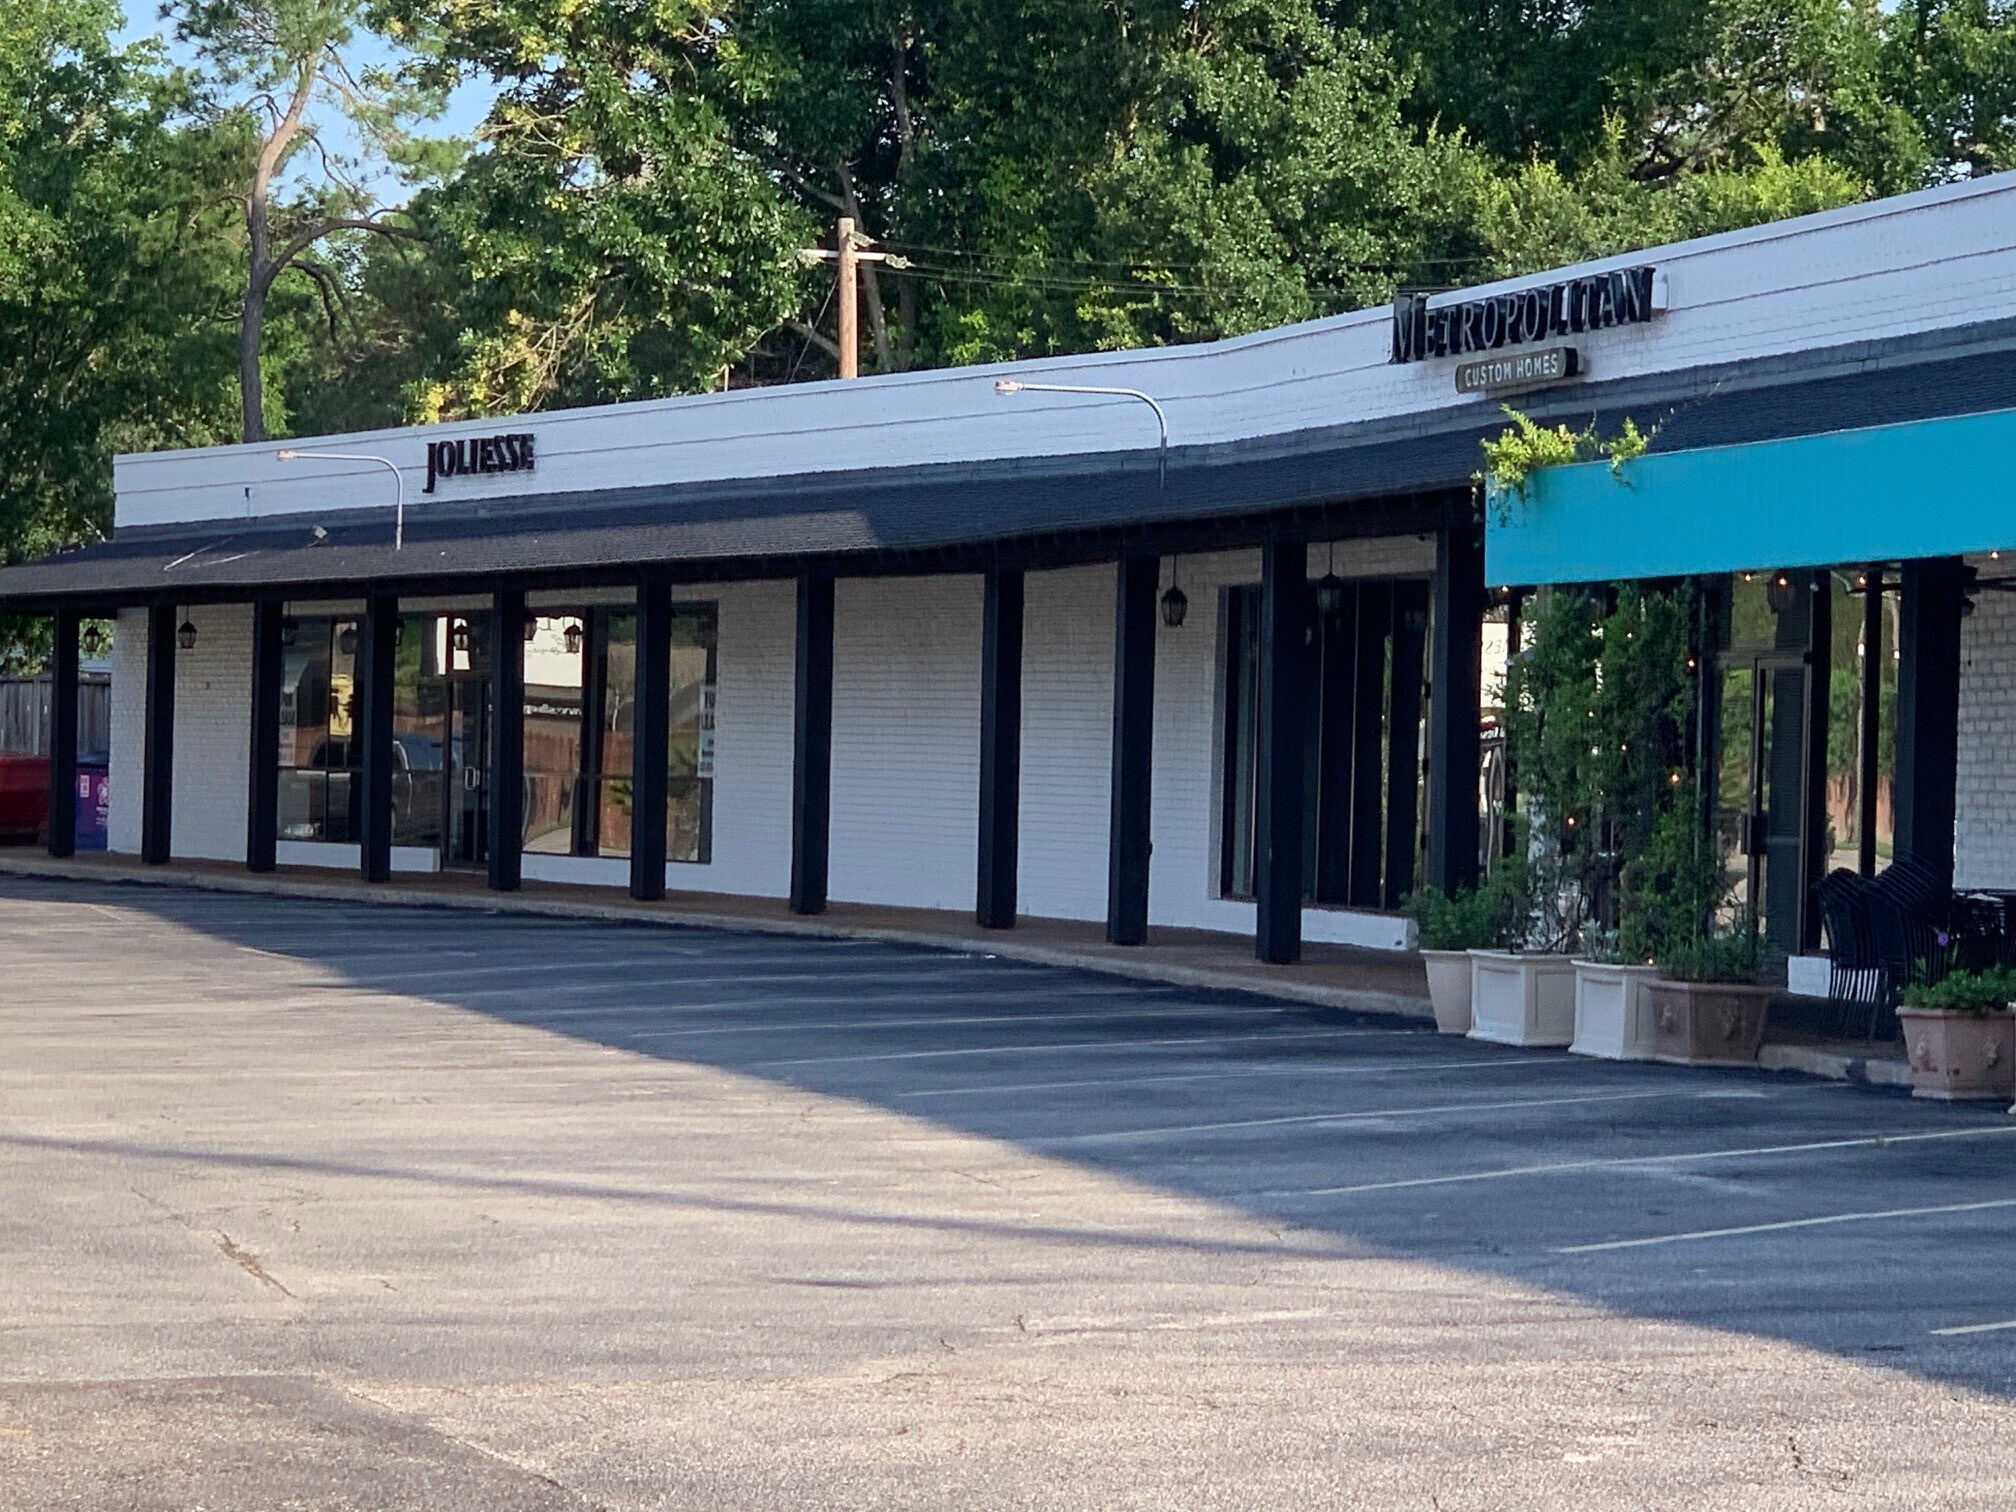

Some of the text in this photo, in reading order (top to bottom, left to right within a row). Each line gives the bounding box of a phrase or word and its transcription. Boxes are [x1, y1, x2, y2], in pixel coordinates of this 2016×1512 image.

[1389, 266, 1655, 365] METROPOLITAN
[1464, 353, 1559, 388] CUSTOM HOMES
[422, 433, 535, 494] JOLIESSE
